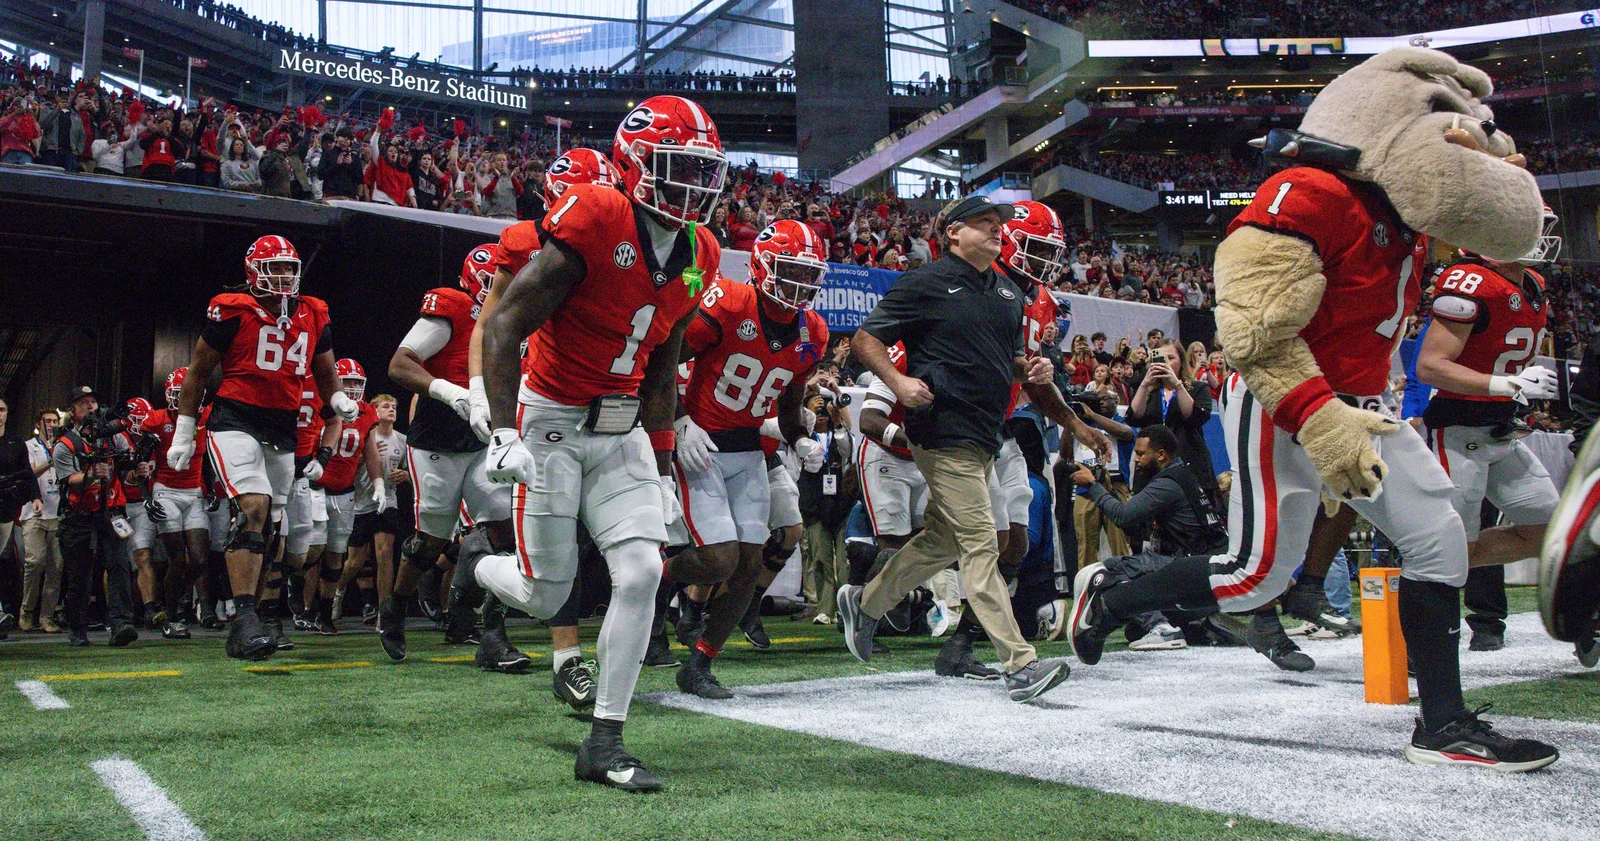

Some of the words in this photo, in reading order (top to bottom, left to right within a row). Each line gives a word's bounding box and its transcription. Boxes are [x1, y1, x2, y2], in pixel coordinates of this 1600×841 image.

[279, 49, 440, 94] Mercedes-Benz
[446, 78, 527, 109] Stadium
[159, 142, 166, 154] 1
[550, 194, 579, 226] 1
[1165, 195, 1186, 205] 3:41
[1187, 195, 1204, 205] PM
[1267, 182, 1293, 215] 1
[615, 243, 636, 268] SEC
[834, 267, 857, 276] Invesco
[1442, 269, 1484, 295] 28
[423, 293, 438, 311] 71
[813, 288, 884, 314] RIDIRO
[608, 302, 658, 377] 1
[740, 319, 757, 337] SEC
[256, 325, 309, 376] 64
[713, 352, 794, 418] 86
[545, 431, 563, 443] G
[1465, 442, 1479, 451] G
